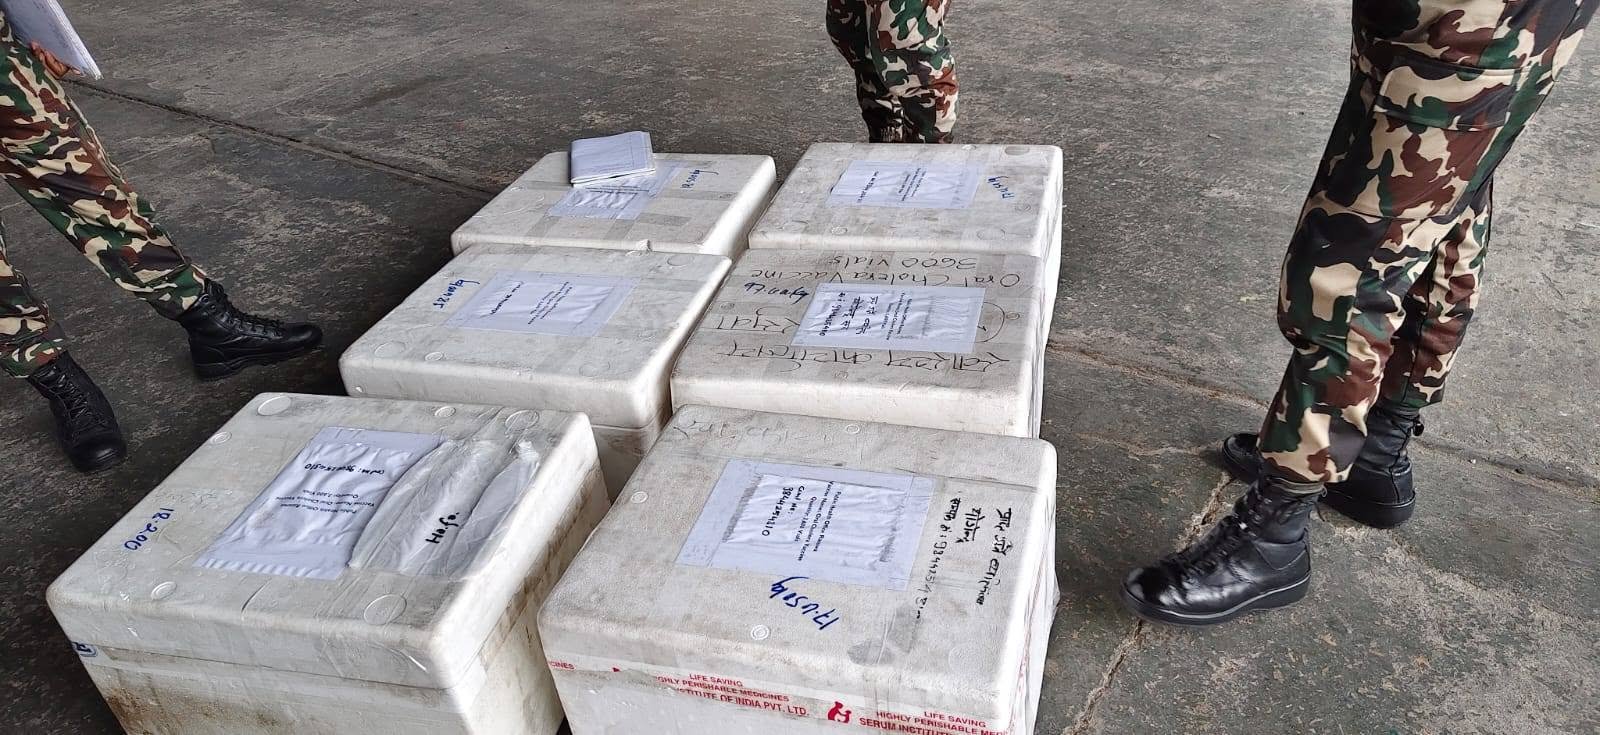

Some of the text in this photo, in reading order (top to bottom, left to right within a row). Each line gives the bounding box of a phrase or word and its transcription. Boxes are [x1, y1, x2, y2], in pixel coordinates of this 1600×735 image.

[901, 257, 977, 270] 3600
[751, 269, 844, 284] Vaccine
[965, 273, 1020, 288] Oral
[689, 673, 743, 688] LIFE SAVING
[681, 679, 739, 696] PERISHABLE
[739, 688, 790, 702] MEDICINES
[735, 696, 762, 709] INDIA
[788, 705, 811, 717] LTD.
[859, 717, 896, 731] SERUM
[876, 711, 911, 723] HIGHLY
[914, 717, 978, 735] PERISHABLE
[924, 711, 987, 728] LIFE SAVING
